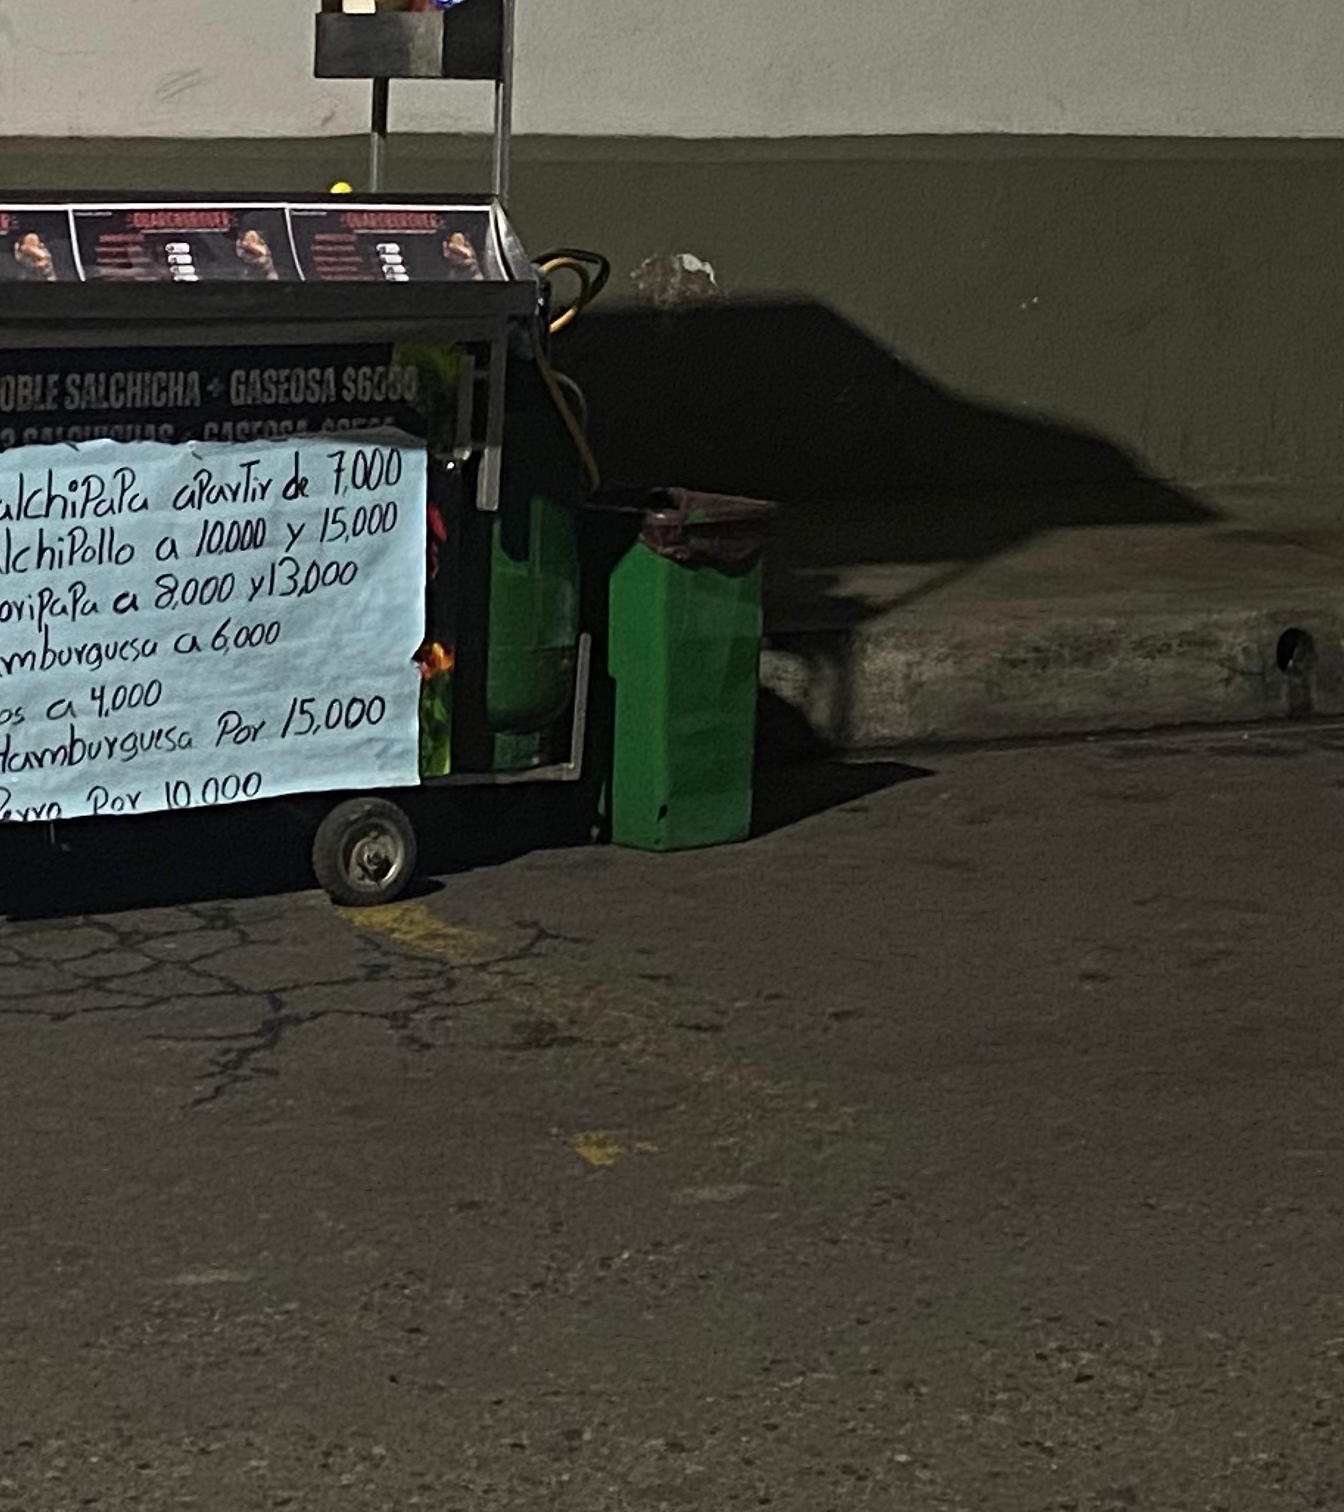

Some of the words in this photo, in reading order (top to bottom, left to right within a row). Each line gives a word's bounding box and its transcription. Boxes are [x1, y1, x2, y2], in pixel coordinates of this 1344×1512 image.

[63, 369, 201, 410] SALCHICHA
[229, 366, 337, 407] GASEOSA
[282, 451, 309, 501] de
[156, 536, 179, 562] a
[285, 522, 306, 553] y
[112, 590, 139, 615] a
[173, 632, 202, 655] a
[46, 698, 77, 720] a
[215, 709, 267, 748] Por
